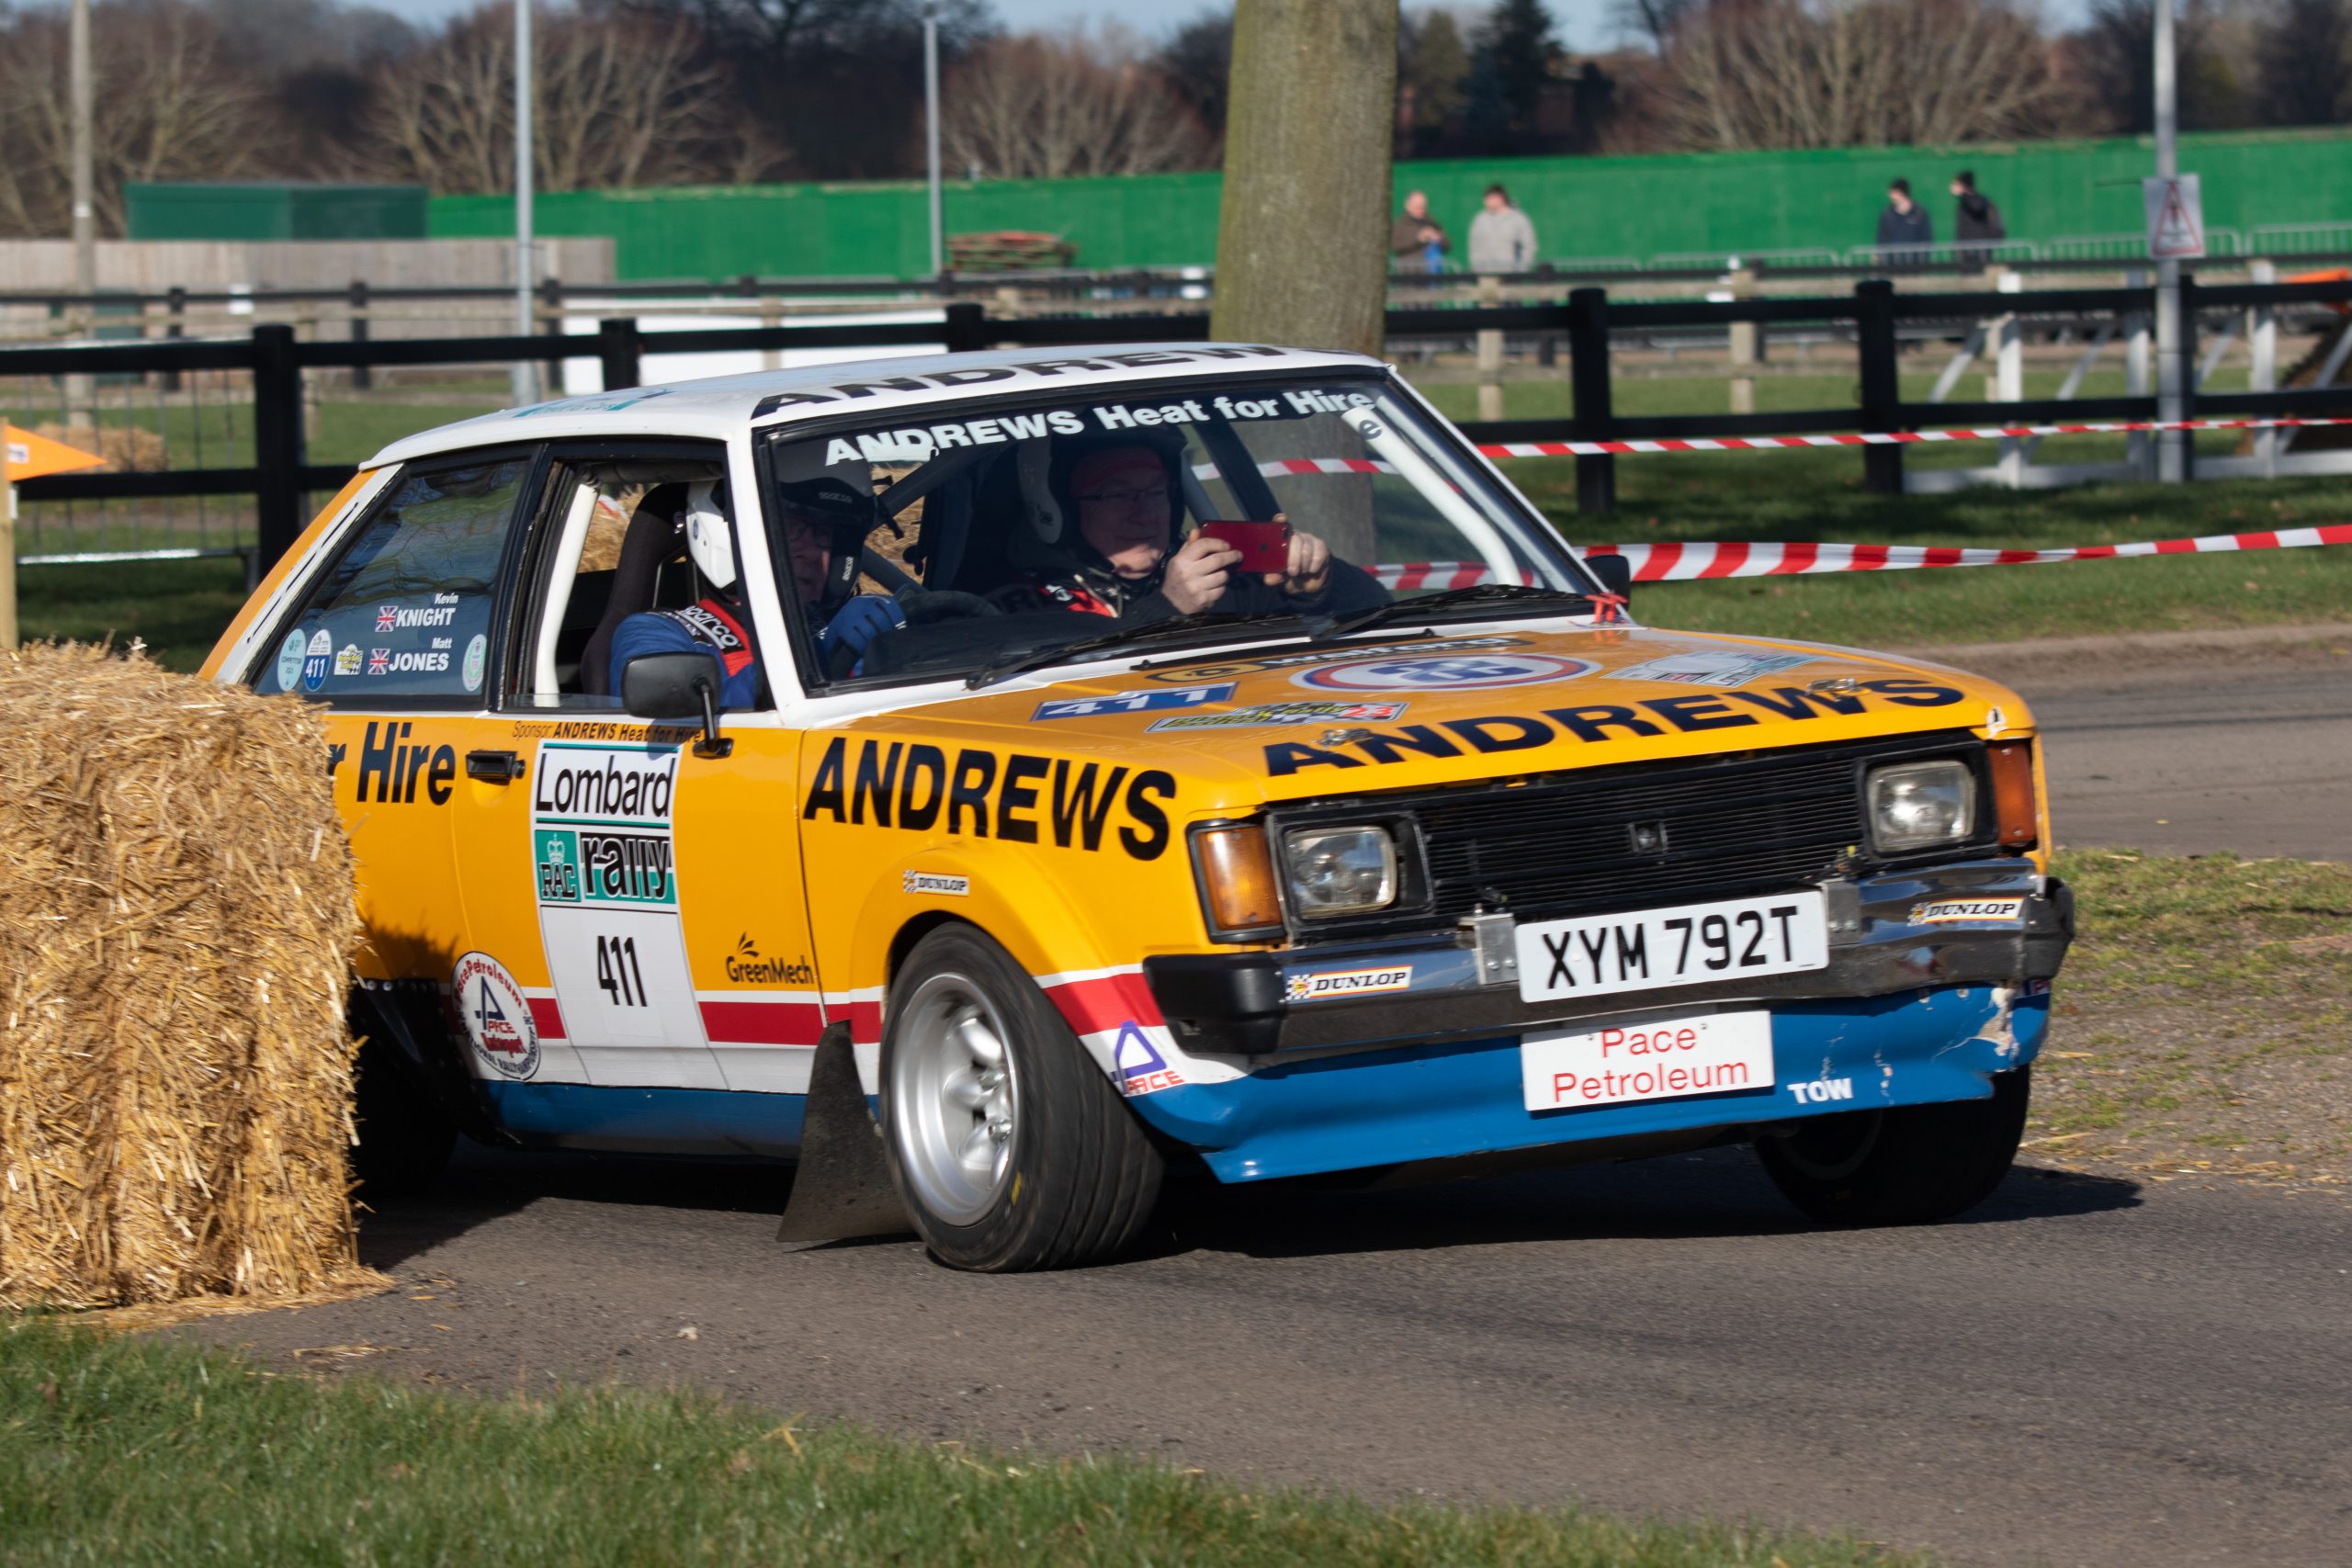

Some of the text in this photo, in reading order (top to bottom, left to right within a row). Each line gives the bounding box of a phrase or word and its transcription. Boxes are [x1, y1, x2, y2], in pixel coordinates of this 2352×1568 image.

[751, 345, 1354, 421] ANDREW
[825, 390, 1376, 466] ANDREWS Heat for Hire
[434, 592, 458, 604] Kevin
[395, 608, 457, 627] KNIGHT
[432, 637, 453, 649] Matt
[305, 658, 326, 678] 411
[389, 652, 450, 671] JONES
[1045, 688, 1209, 716] 411
[553, 722, 616, 739] ANDREWS
[618, 725, 648, 741] Heat
[650, 725, 671, 742] for
[674, 727, 701, 743] Hire
[1261, 679, 1967, 777] ANDREWS
[356, 721, 457, 807] Hire
[536, 752, 677, 818] Lombard
[803, 737, 1177, 862] ANDREWS
[540, 862, 577, 900] RAC
[581, 837, 671, 900] rally
[918, 877, 967, 891] DUNLOP
[1928, 902, 2016, 917] DUNLOP
[1543, 905, 1799, 989] XYM 792T
[596, 935, 649, 1008] 411
[725, 954, 815, 984] GreenMech
[1315, 971, 1407, 992] DUNLOP
[1600, 1027, 1697, 1058] Pace
[1124, 1070, 1186, 1096] PACE
[1554, 1061, 1748, 1103] Petroleum
[1787, 1077, 1853, 1104] TOW
